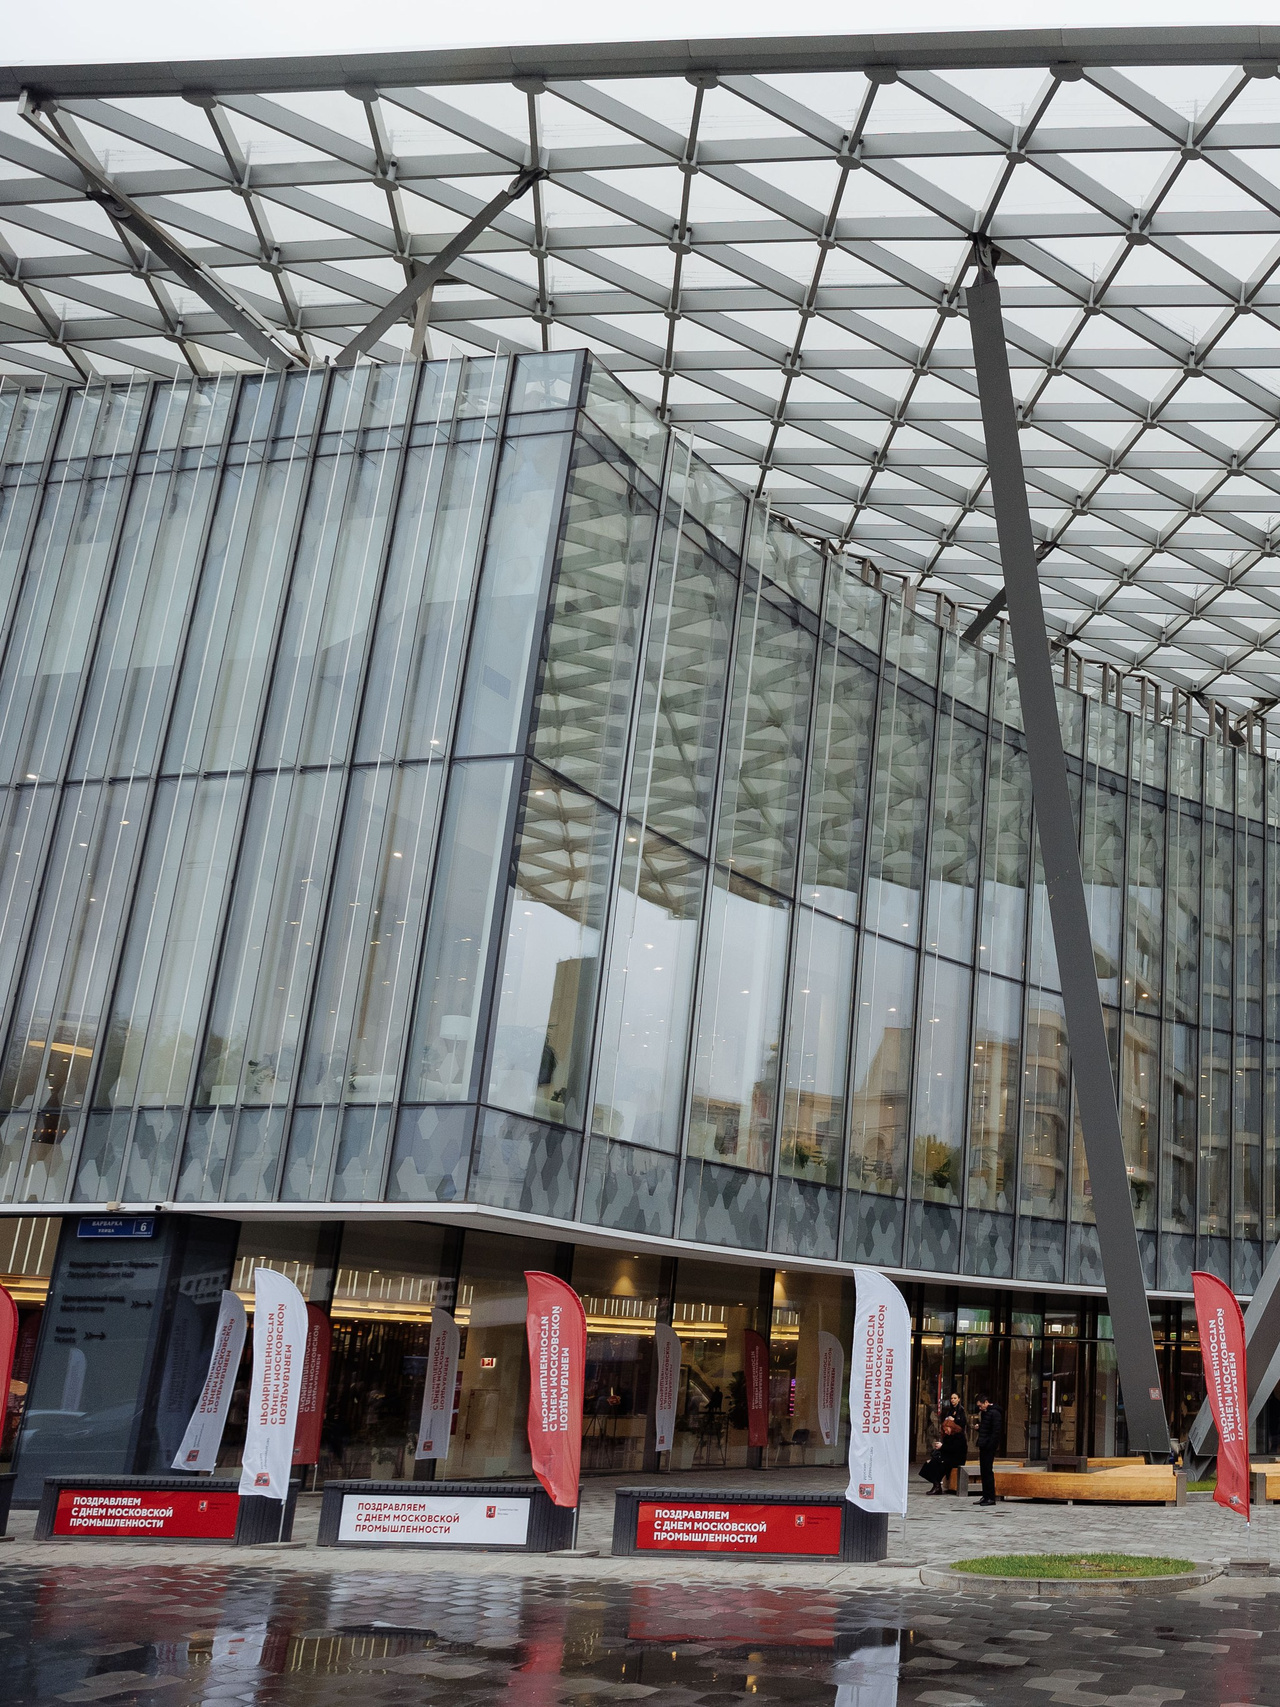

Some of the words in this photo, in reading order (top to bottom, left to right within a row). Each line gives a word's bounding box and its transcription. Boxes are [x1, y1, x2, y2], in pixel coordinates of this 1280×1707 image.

[140, 1222, 147, 1232] 6
[73, 1497, 141, 1506] ПОЗДРАВЛЯЕМ
[357, 1502, 426, 1512] ПОЗДРАВЛЯЕМ
[72, 1508, 79, 1516] С
[79, 1508, 106, 1518] ДНЕМ
[107, 1507, 173, 1518] МОСКОВСКОЙ
[655, 1510, 729, 1520] ПОЗДРАВЛЯЕМ
[70, 1518, 164, 1528] ПРОМЫШЛЕННОСТИ
[356, 1513, 363, 1522] С
[364, 1514, 391, 1523] ДНЕМ
[393, 1513, 460, 1523] МОСКОВСКОЙ
[355, 1524, 451, 1534] ПРОМЫШЛЕННОСТИ
[654, 1521, 662, 1530] С
[662, 1521, 692, 1531] ДНЕМ
[694, 1522, 766, 1532] МОСКОВСКОЙ
[654, 1532, 758, 1543] ПРОМЫШЛЕННОСТИ
